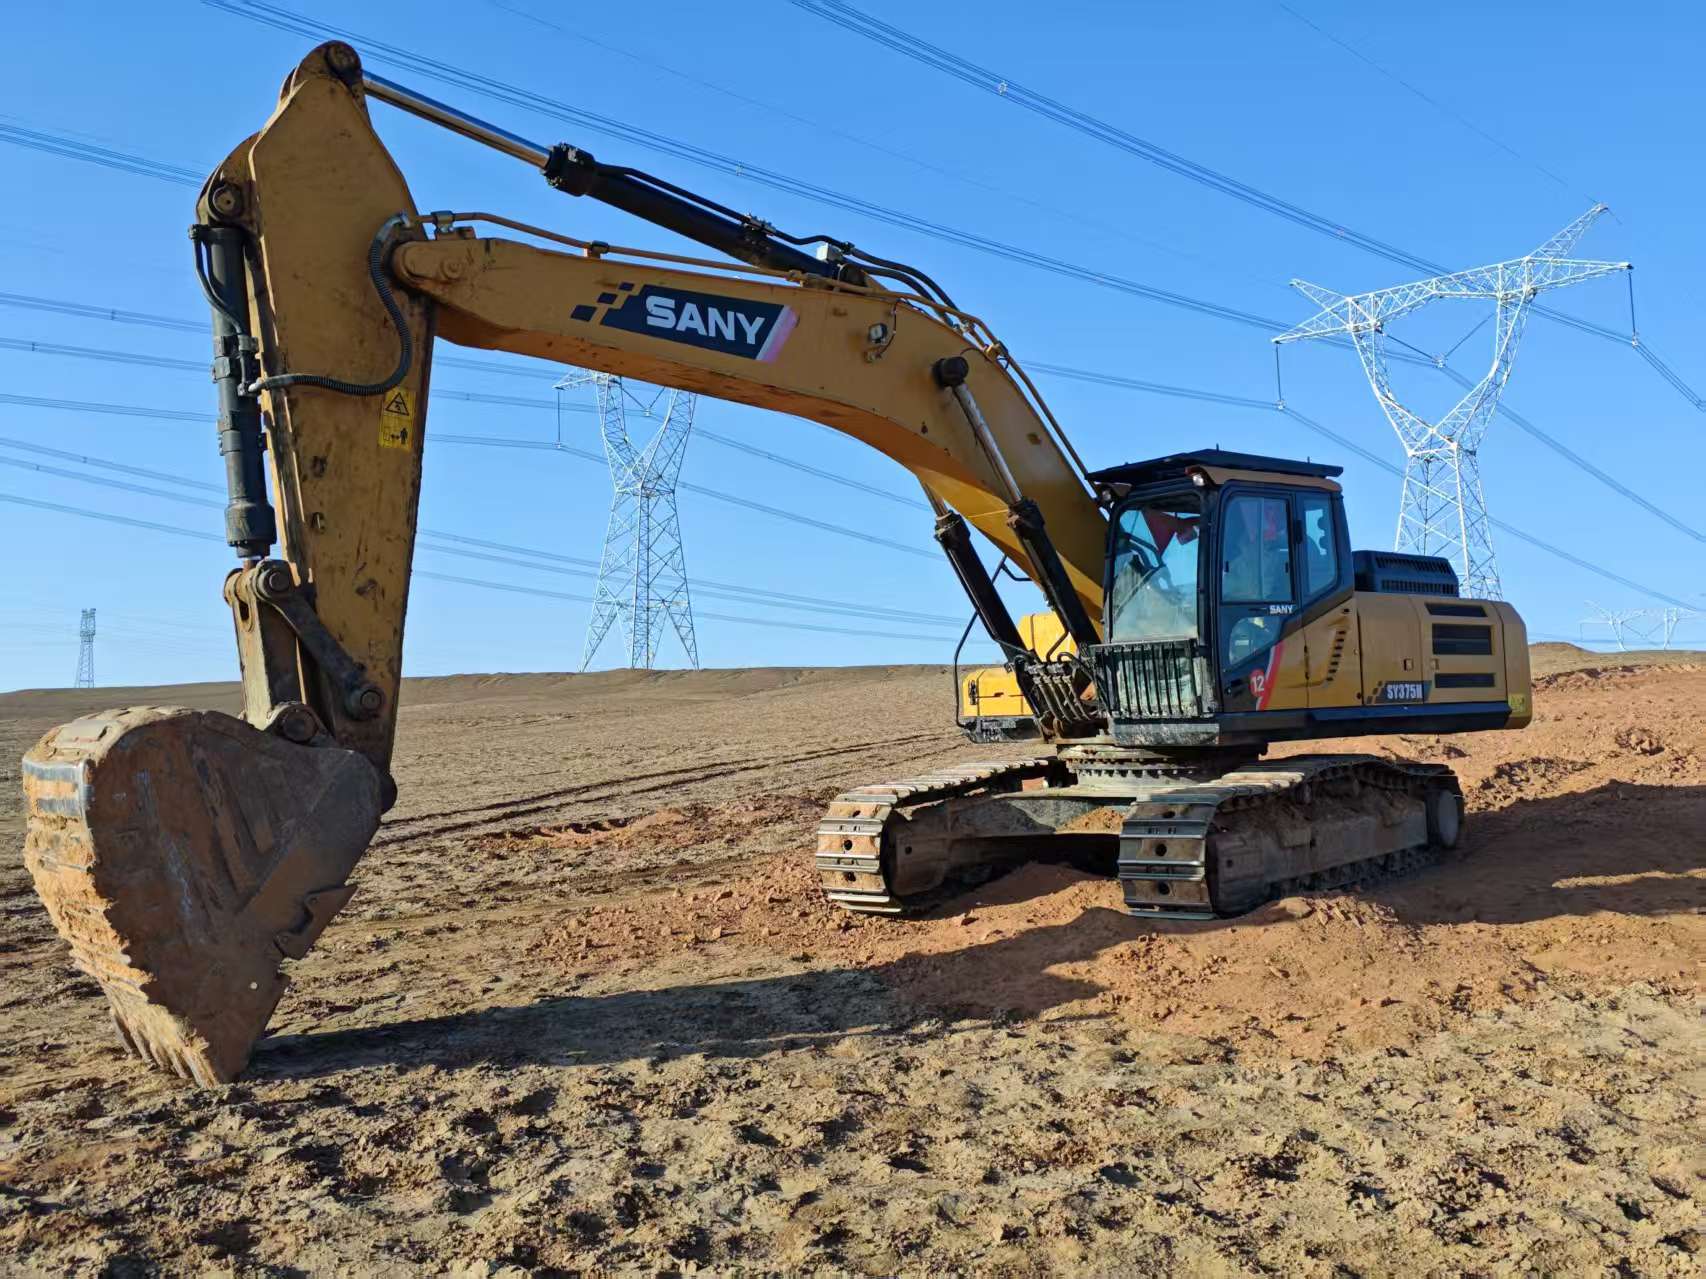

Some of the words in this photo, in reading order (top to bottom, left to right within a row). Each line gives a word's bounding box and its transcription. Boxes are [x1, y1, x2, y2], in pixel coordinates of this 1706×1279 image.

[645, 295, 766, 345] SANY
[1269, 604, 1294, 614] SANY
[1252, 675, 1265, 692] 12
